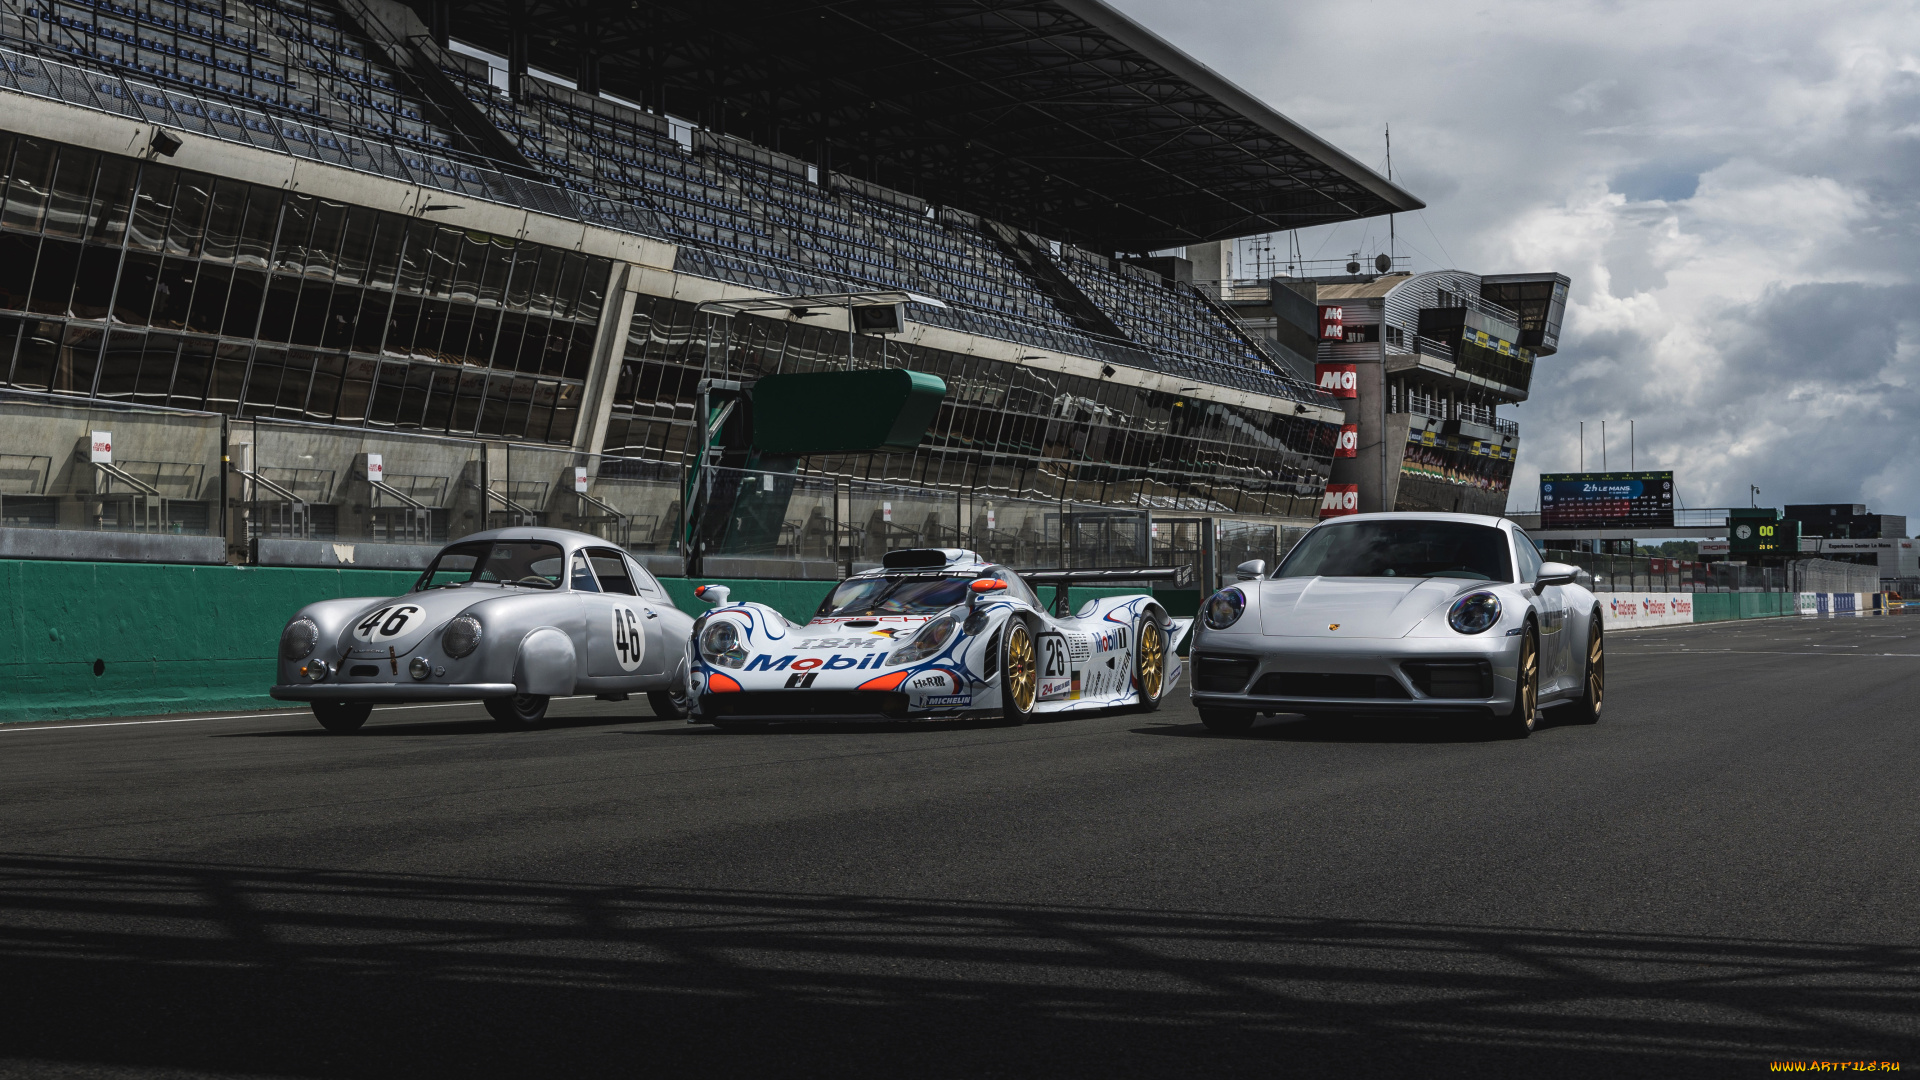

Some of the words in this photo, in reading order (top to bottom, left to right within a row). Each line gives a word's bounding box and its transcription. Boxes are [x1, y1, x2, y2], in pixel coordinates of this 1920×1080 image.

[1759, 525, 1774, 537] 00
[358, 606, 418, 636] 46
[614, 608, 641, 663] 46
[792, 637, 884, 650] IBM
[1091, 629, 1118, 653] Mobil
[743, 652, 889, 671] Mobil
[1045, 638, 1065, 676] 26
[1115, 648, 1132, 696] BILSTEIN
[913, 677, 935, 689] H&R
[1042, 682, 1053, 696] 24
[928, 696, 971, 705] MICHELIN
